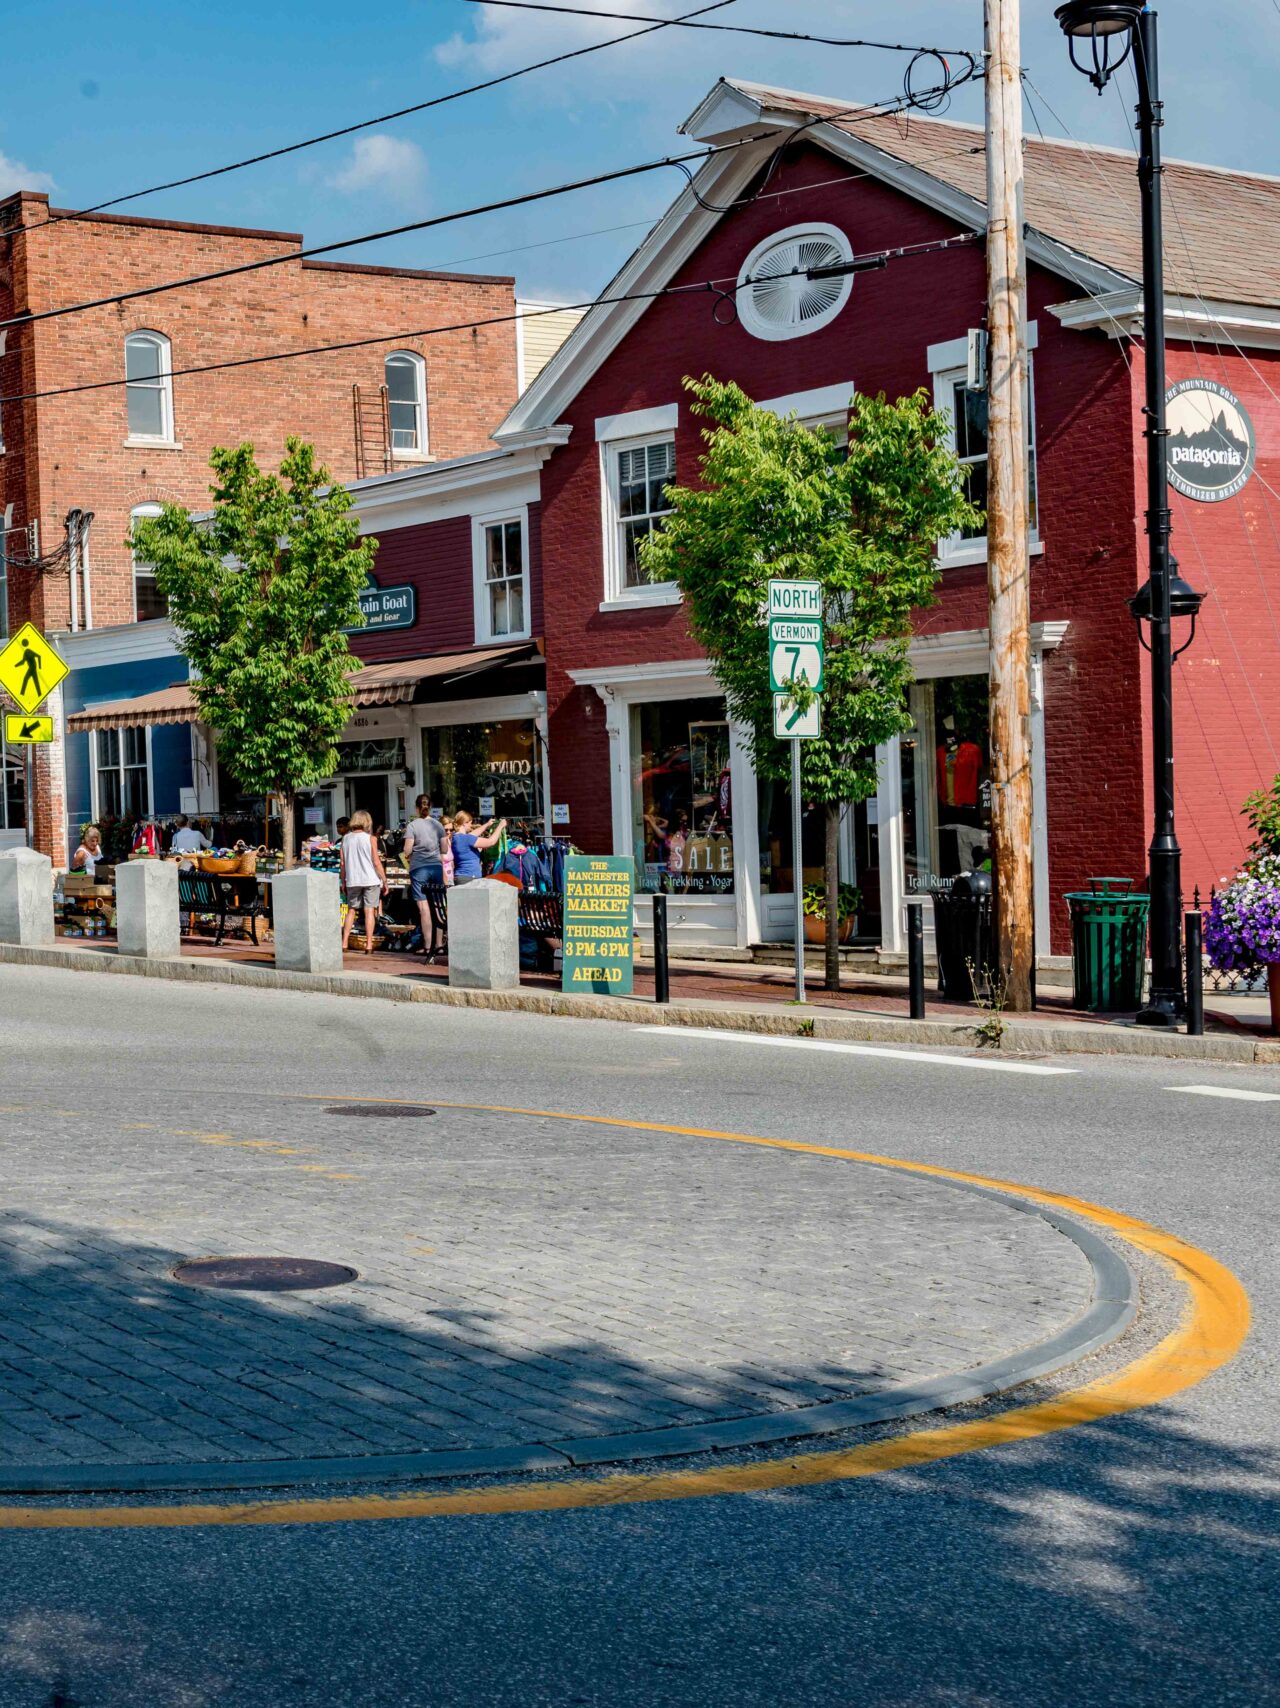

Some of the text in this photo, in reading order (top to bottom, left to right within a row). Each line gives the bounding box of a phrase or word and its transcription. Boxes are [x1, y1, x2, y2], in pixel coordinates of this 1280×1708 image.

[1179, 379, 1218, 392] MOUNTAIN
[1219, 388, 1239, 406] GOAT
[1171, 445, 1242, 468] patagonia
[1219, 473, 1248, 498] DEALER
[382, 594, 408, 611] Goat
[773, 588, 818, 609] NORTH
[369, 613, 383, 623] and
[384, 612, 400, 622] Gear
[774, 625, 818, 639] VERMONT
[590, 861, 608, 870] THE
[674, 846, 729, 870] SALE
[567, 871, 630, 882] MANCHESTER
[639, 874, 733, 890] Travel Trekking Yoga
[908, 874, 955, 889] Trail Runn
[566, 883, 631, 897] FARMERS
[567, 898, 629, 912] MARKET
[565, 925, 629, 938] THURSDAY
[565, 941, 573, 956] 3
[572, 967, 623, 982] AHEAD
